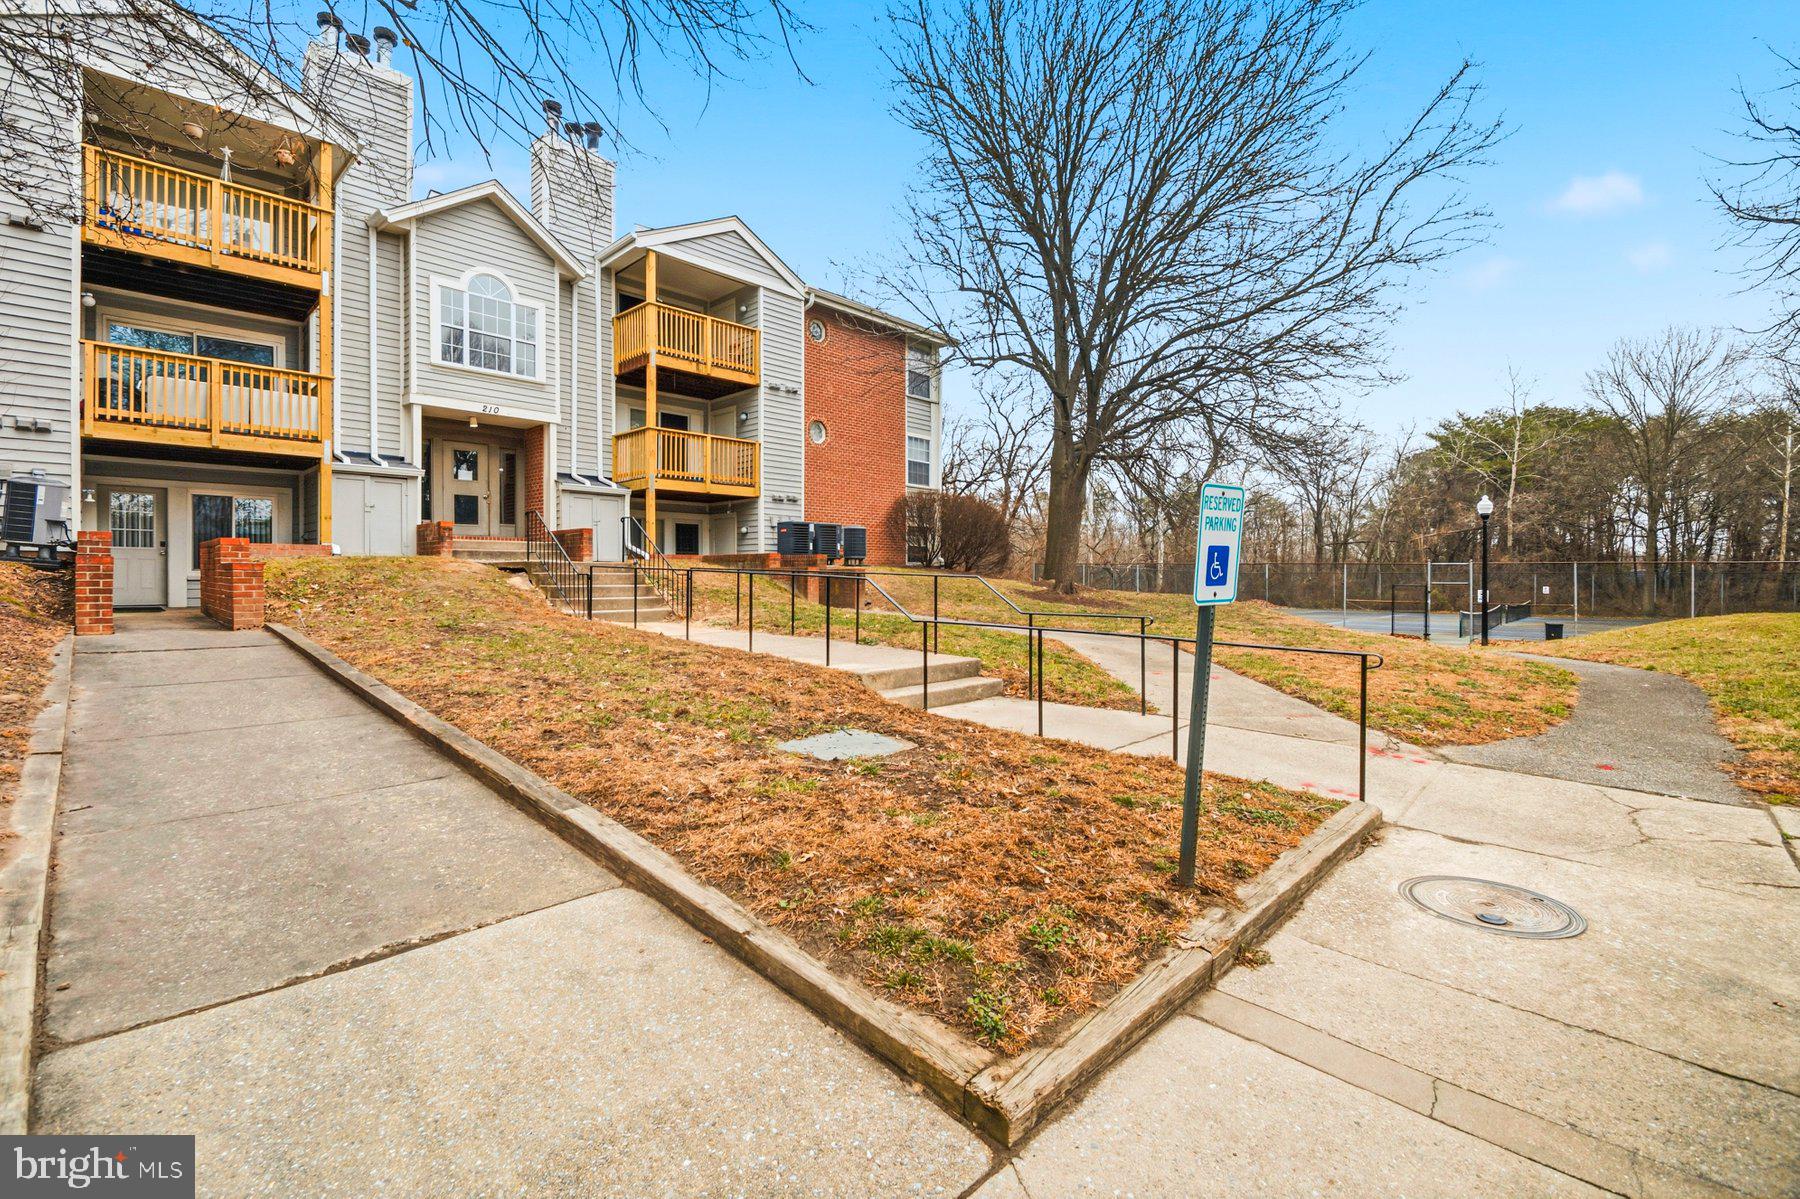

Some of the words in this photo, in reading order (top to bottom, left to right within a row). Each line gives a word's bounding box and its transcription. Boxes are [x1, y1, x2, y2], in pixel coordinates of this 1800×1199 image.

[482, 405, 500, 414] 210
[1204, 495, 1241, 512] RESERVED
[1205, 516, 1237, 532] PARKING
